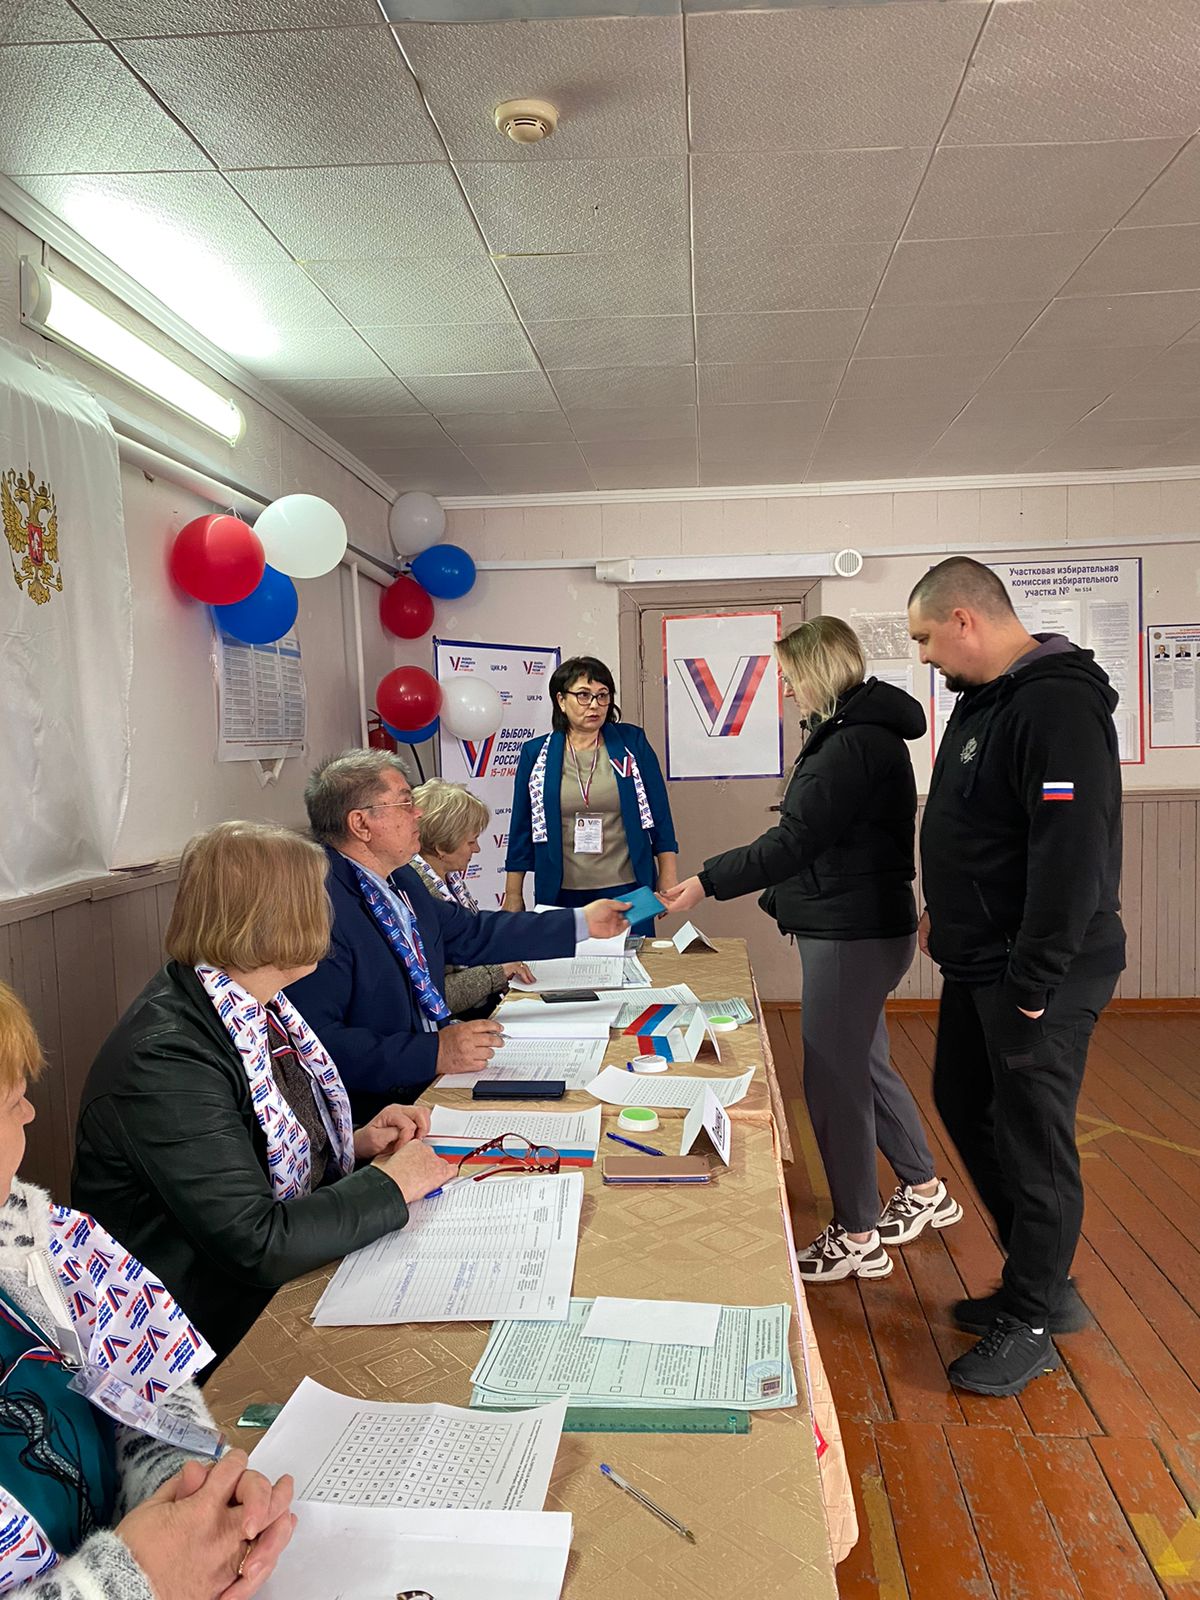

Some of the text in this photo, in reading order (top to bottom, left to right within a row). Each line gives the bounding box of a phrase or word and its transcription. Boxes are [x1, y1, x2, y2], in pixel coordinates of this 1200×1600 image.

[1009, 564, 1120, 577] Участковая избирательная
[1012, 574, 1119, 587] комиссия избирательного
[1024, 588, 1057, 598] участка
[500, 728, 535, 738] ВЫБОРЫ
[496, 742, 522, 752] ПРЕЗИ
[493, 754, 520, 765] РОССИ
[507, 768, 515, 777] МА
